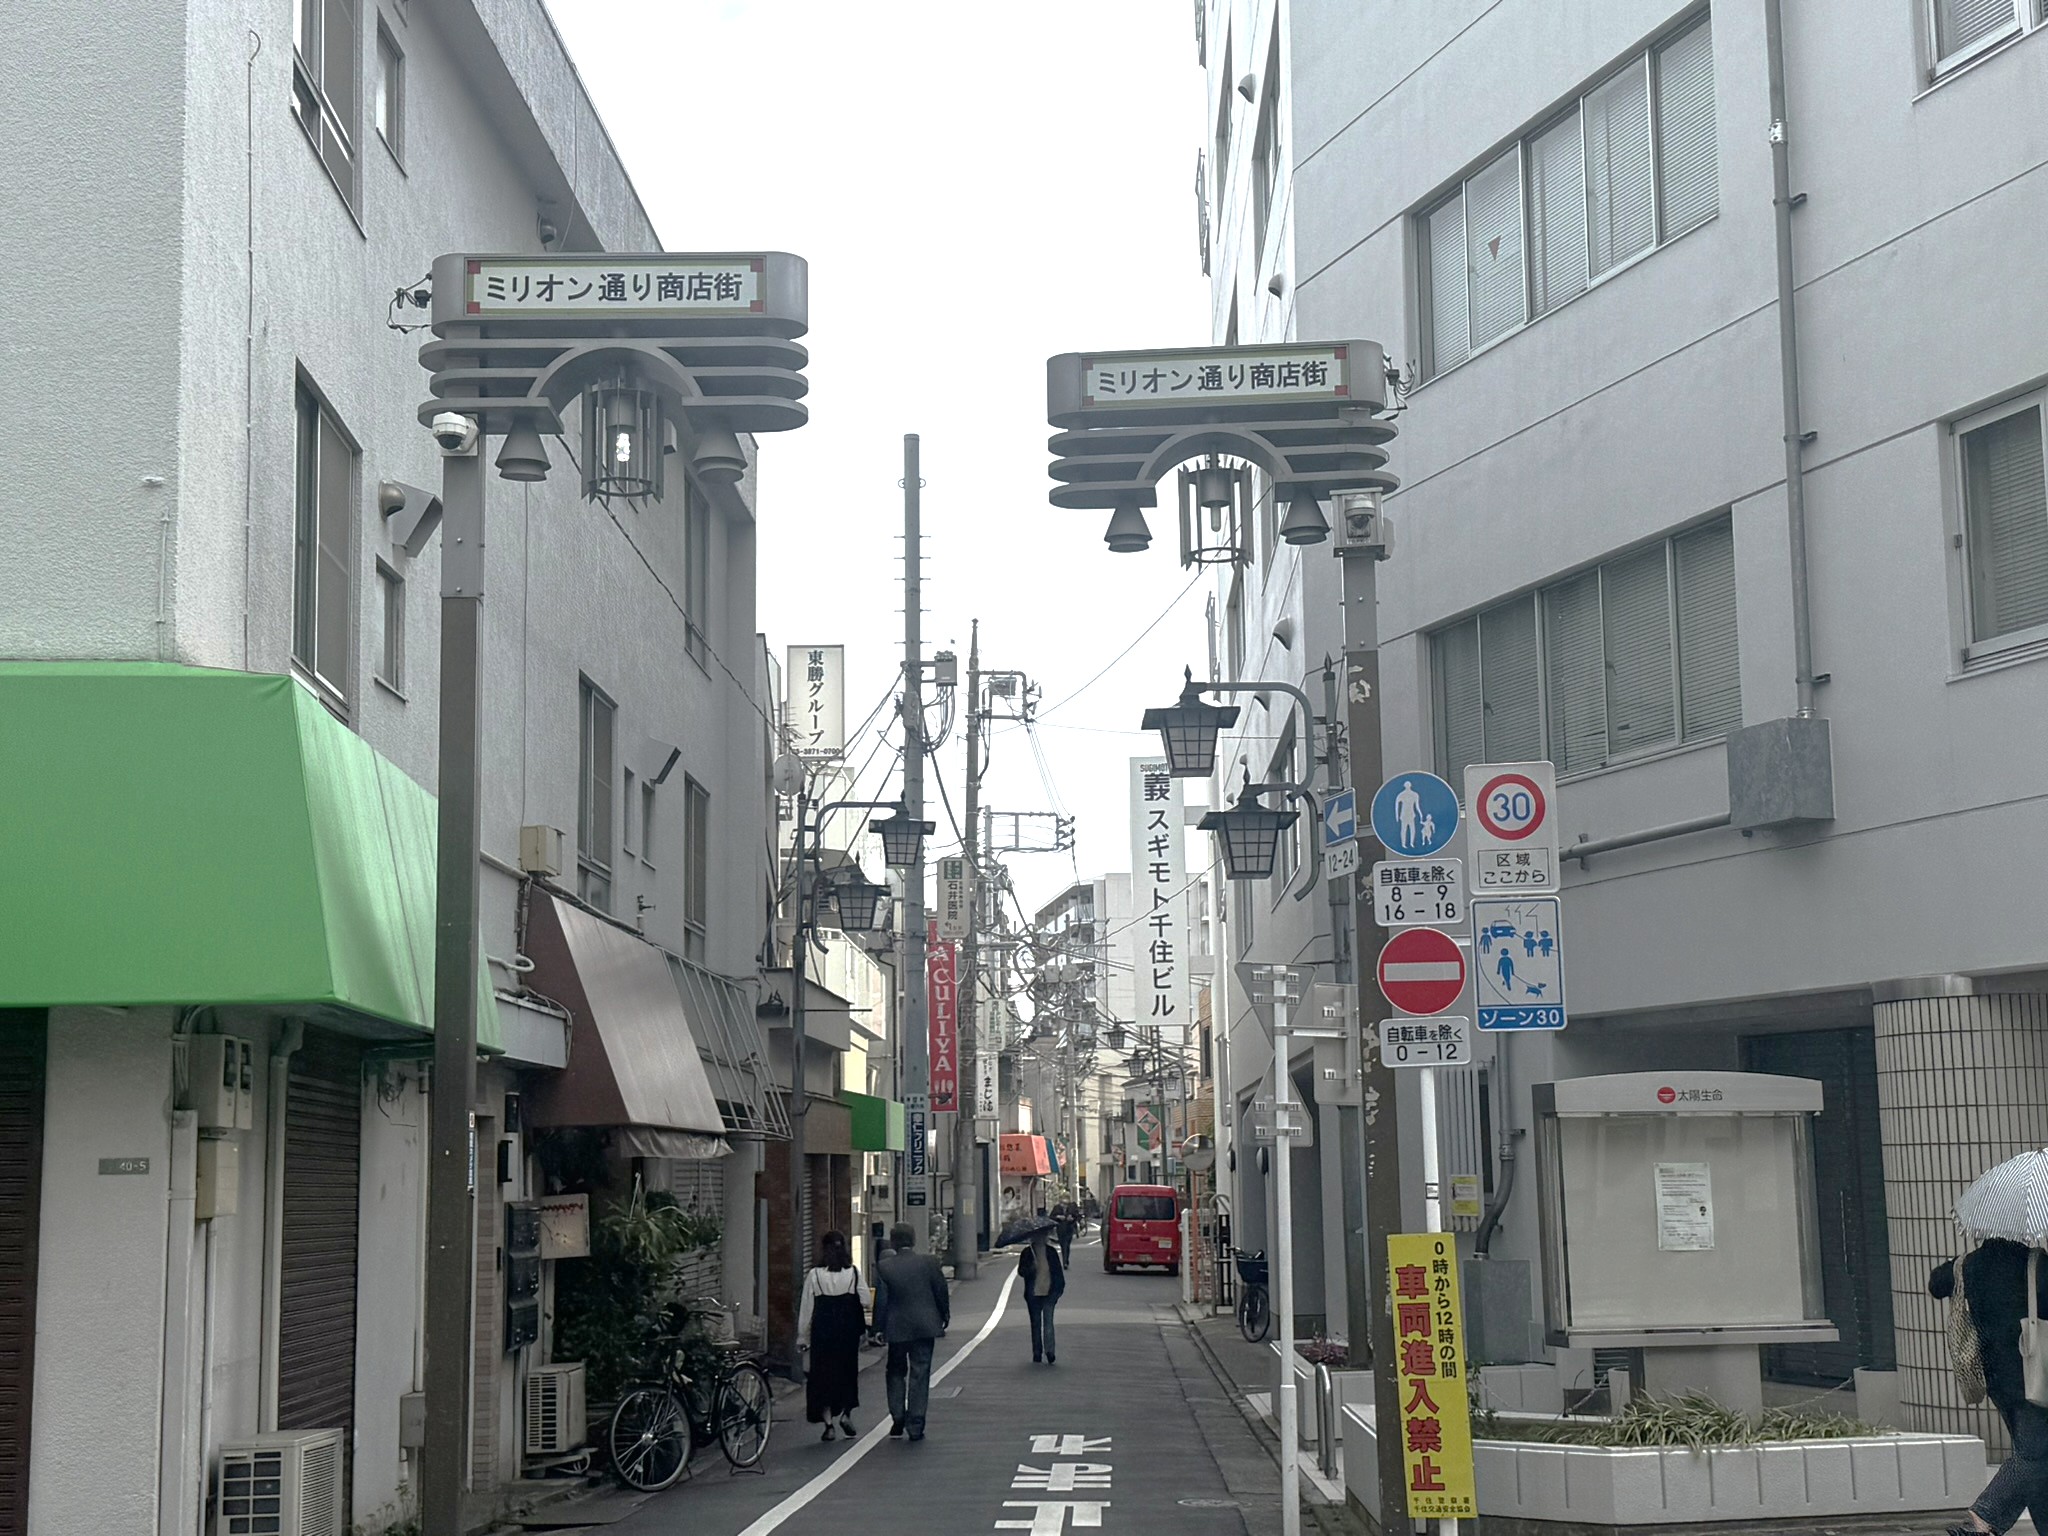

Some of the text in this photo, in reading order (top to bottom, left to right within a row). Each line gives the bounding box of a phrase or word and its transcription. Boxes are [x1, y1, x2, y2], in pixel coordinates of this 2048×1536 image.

[486, 272, 743, 302] ミリオン通り商店街
[1099, 360, 1328, 395] ミリオン通り商店街
[807, 650, 824, 746] 東勝グループ
[1139, 762, 1169, 773] SUGIMOT
[1492, 792, 1531, 822] 30
[1327, 848, 1355, 873] 12-24
[1496, 852, 1531, 868] 区域
[1380, 866, 1454, 884] 自転車を除く
[1483, 868, 1546, 885] ここから
[1481, 1008, 1560, 1026] ゾーン30
[1387, 1025, 1463, 1042] 自転車を除く
[1677, 1088, 1723, 1102] 太陽生命
[1432, 1241, 1458, 1380] 0時から12時の間
[1395, 1263, 1446, 1492] 車両進入禁止
